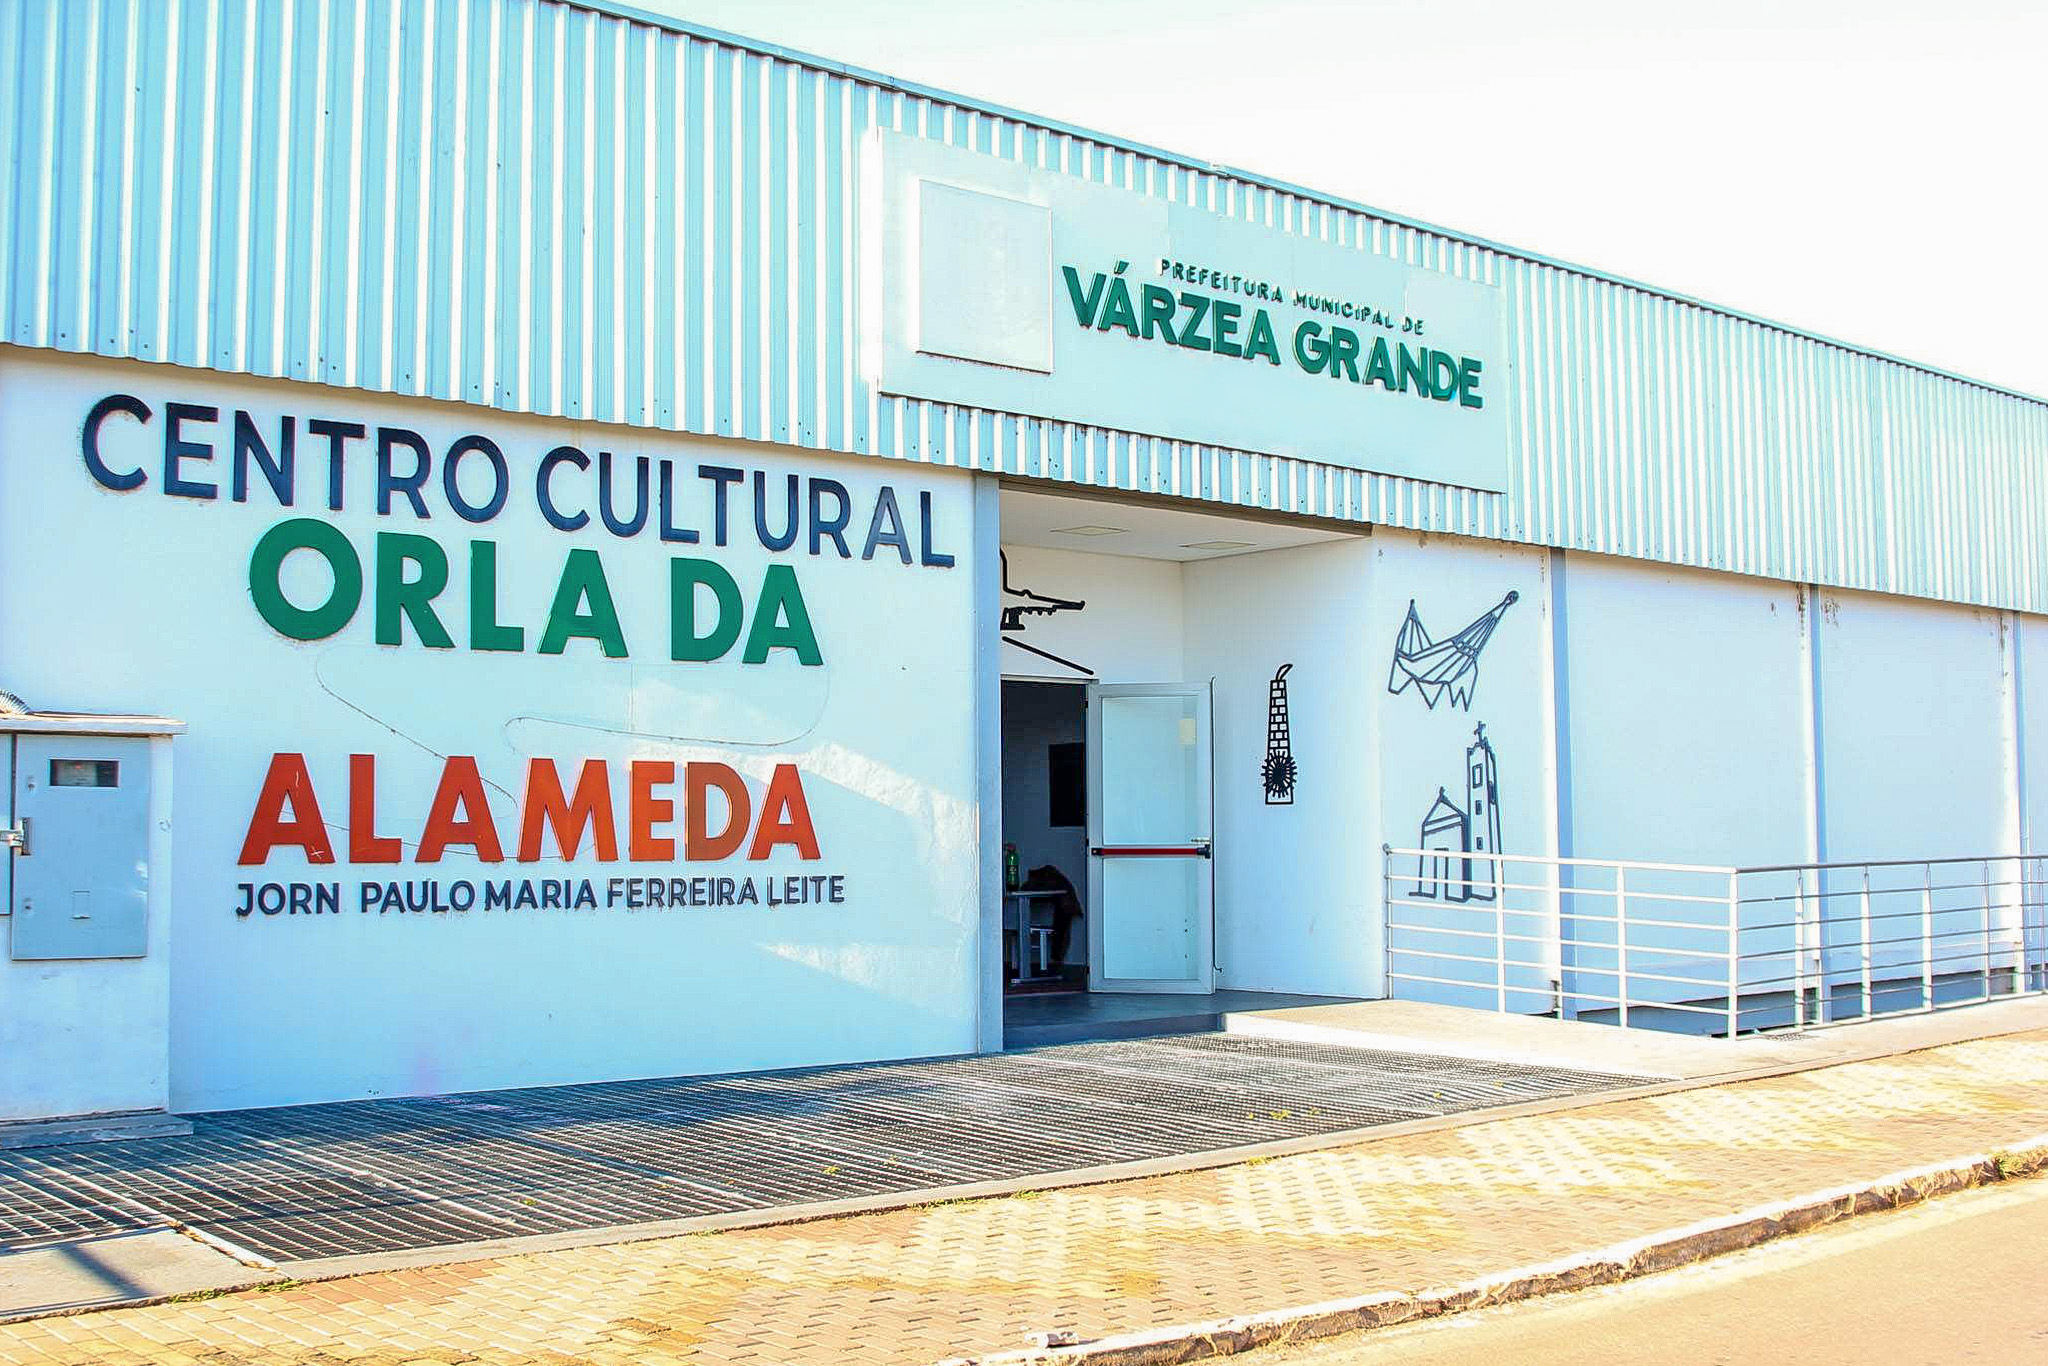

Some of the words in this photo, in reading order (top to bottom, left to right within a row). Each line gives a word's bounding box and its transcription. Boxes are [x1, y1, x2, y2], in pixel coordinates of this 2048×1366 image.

[1062, 261, 1281, 365] VÁRZEA
[1294, 318, 1484, 408] GRANDE
[1160, 259, 1284, 303] PREFEITURA
[1293, 291, 1394, 330] MUNICIPAL
[1403, 316, 1424, 335] DE
[83, 394, 510, 523] CENTRO
[535, 445, 956, 568] CULTURAL
[249, 517, 629, 659] ORLA
[671, 557, 824, 667] DA
[237, 752, 822, 865] ALAMEDA
[236, 881, 340, 917] JORN
[359, 878, 476, 914] PAULO
[484, 878, 598, 911] MARIA
[606, 876, 760, 909] FERREIRA
[766, 875, 846, 906] LEITE
